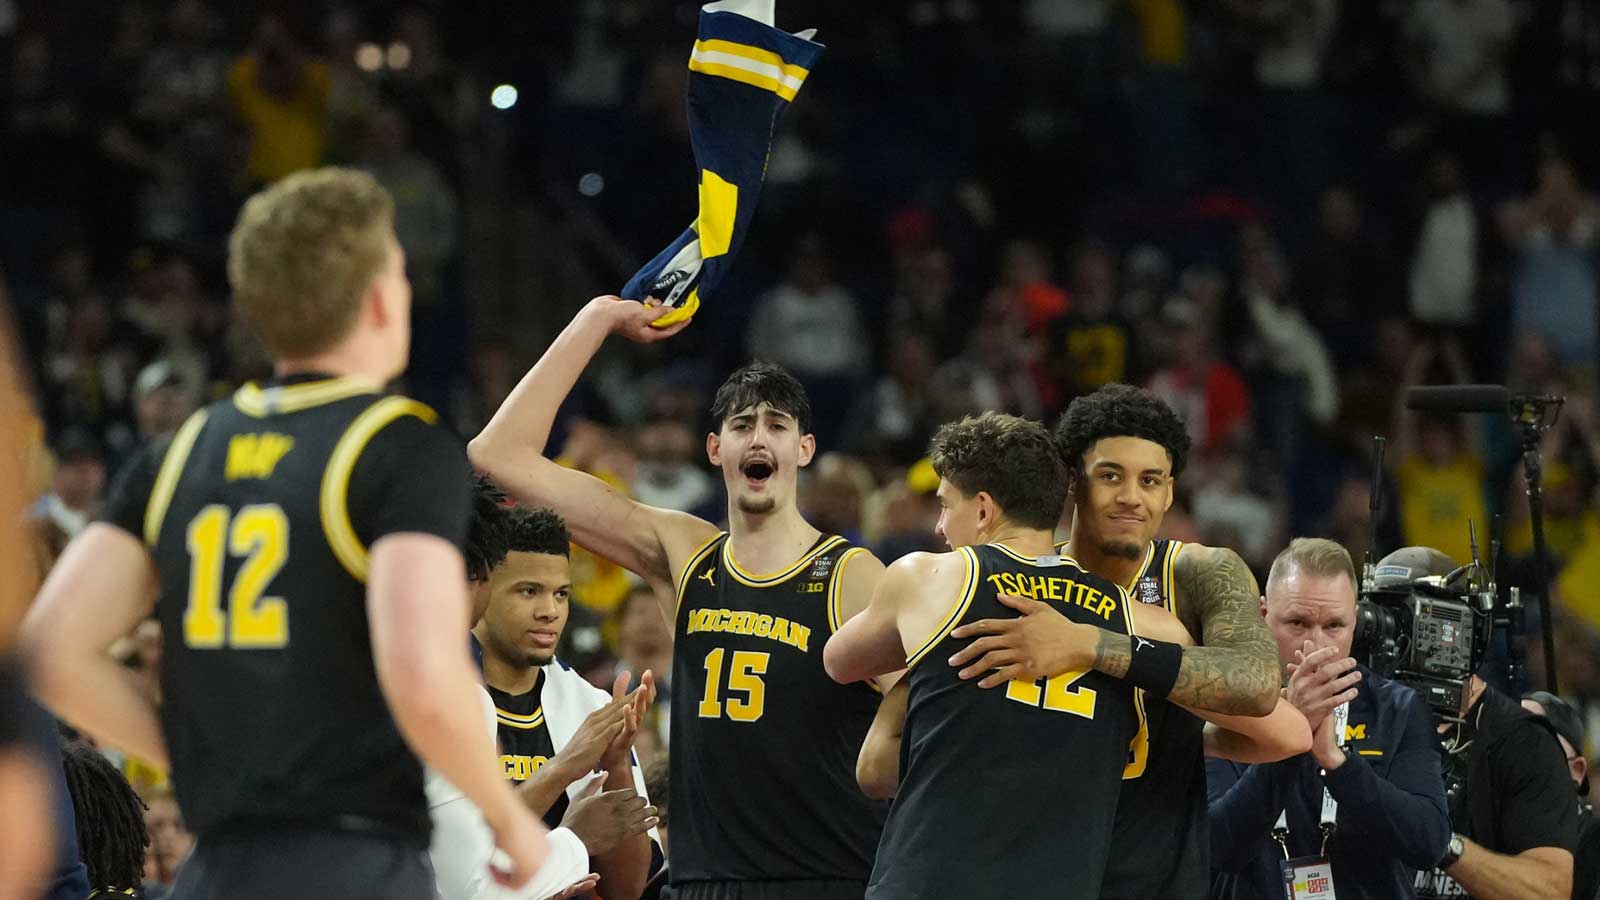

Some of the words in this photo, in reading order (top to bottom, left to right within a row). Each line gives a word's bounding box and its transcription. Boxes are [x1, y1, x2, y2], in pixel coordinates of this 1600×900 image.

[183, 503, 290, 649] 12
[986, 572, 1117, 621] TSCHETTER
[1140, 582, 1158, 590] FINAL
[1142, 594, 1161, 604] FOUR
[687, 608, 811, 653] MICHIGAN
[698, 647, 771, 723] 15
[1345, 723, 1367, 741] M
